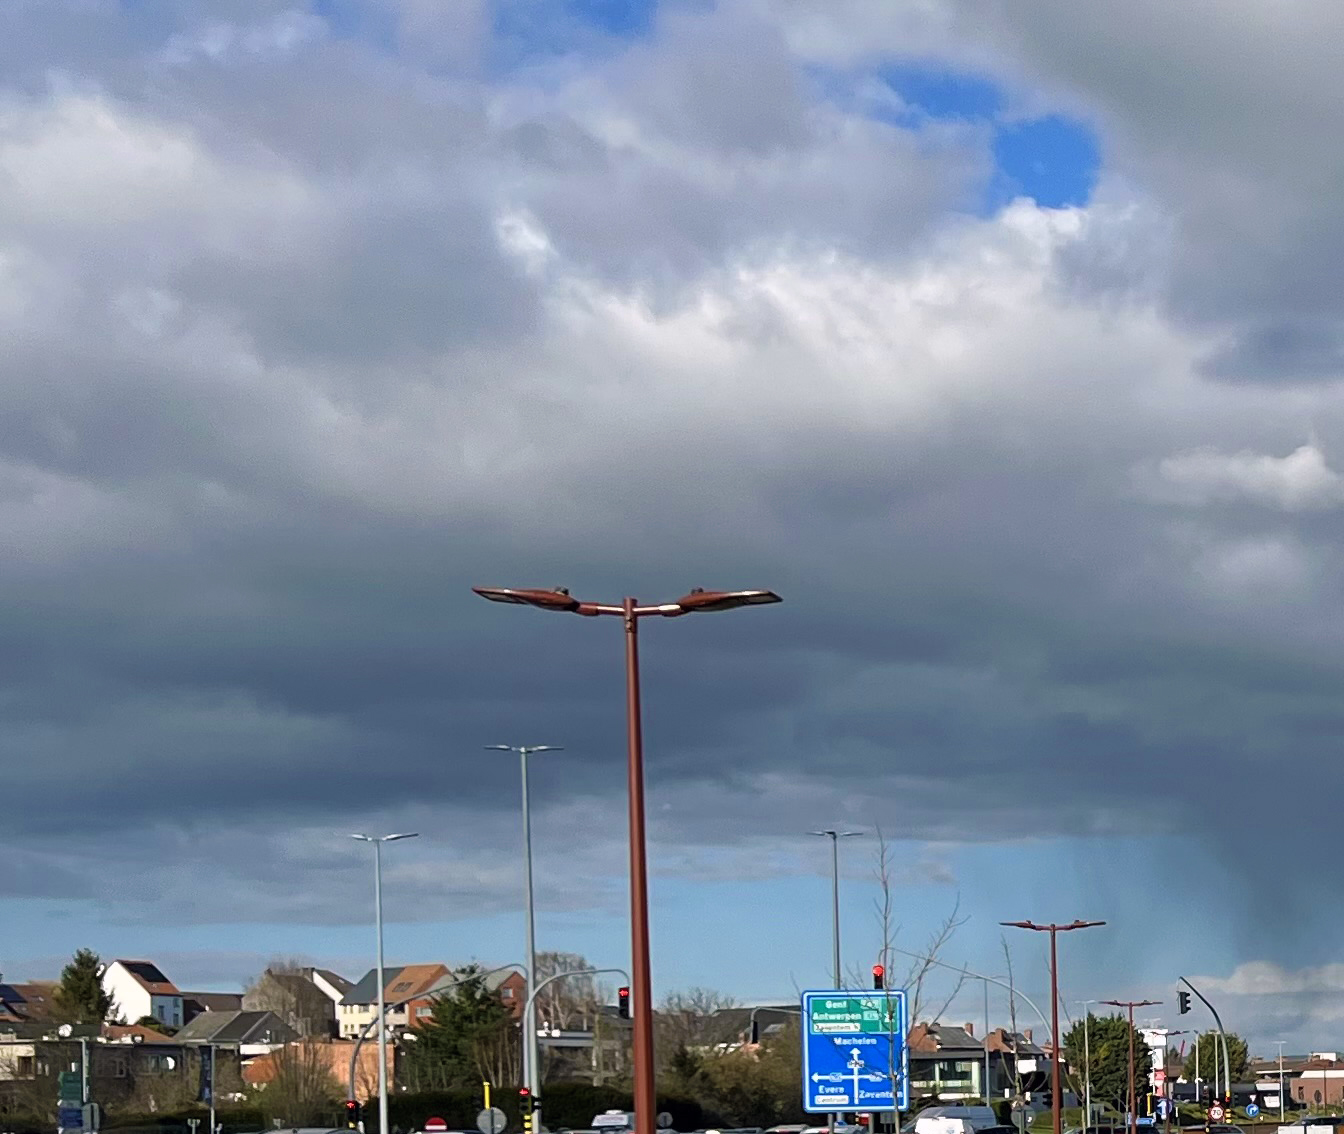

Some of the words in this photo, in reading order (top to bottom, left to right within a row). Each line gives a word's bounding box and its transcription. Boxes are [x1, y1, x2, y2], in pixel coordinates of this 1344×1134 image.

[812, 1012, 862, 1021] Antwerpen
[833, 1037, 877, 1046] Machelen
[818, 1085, 845, 1094] Evere
